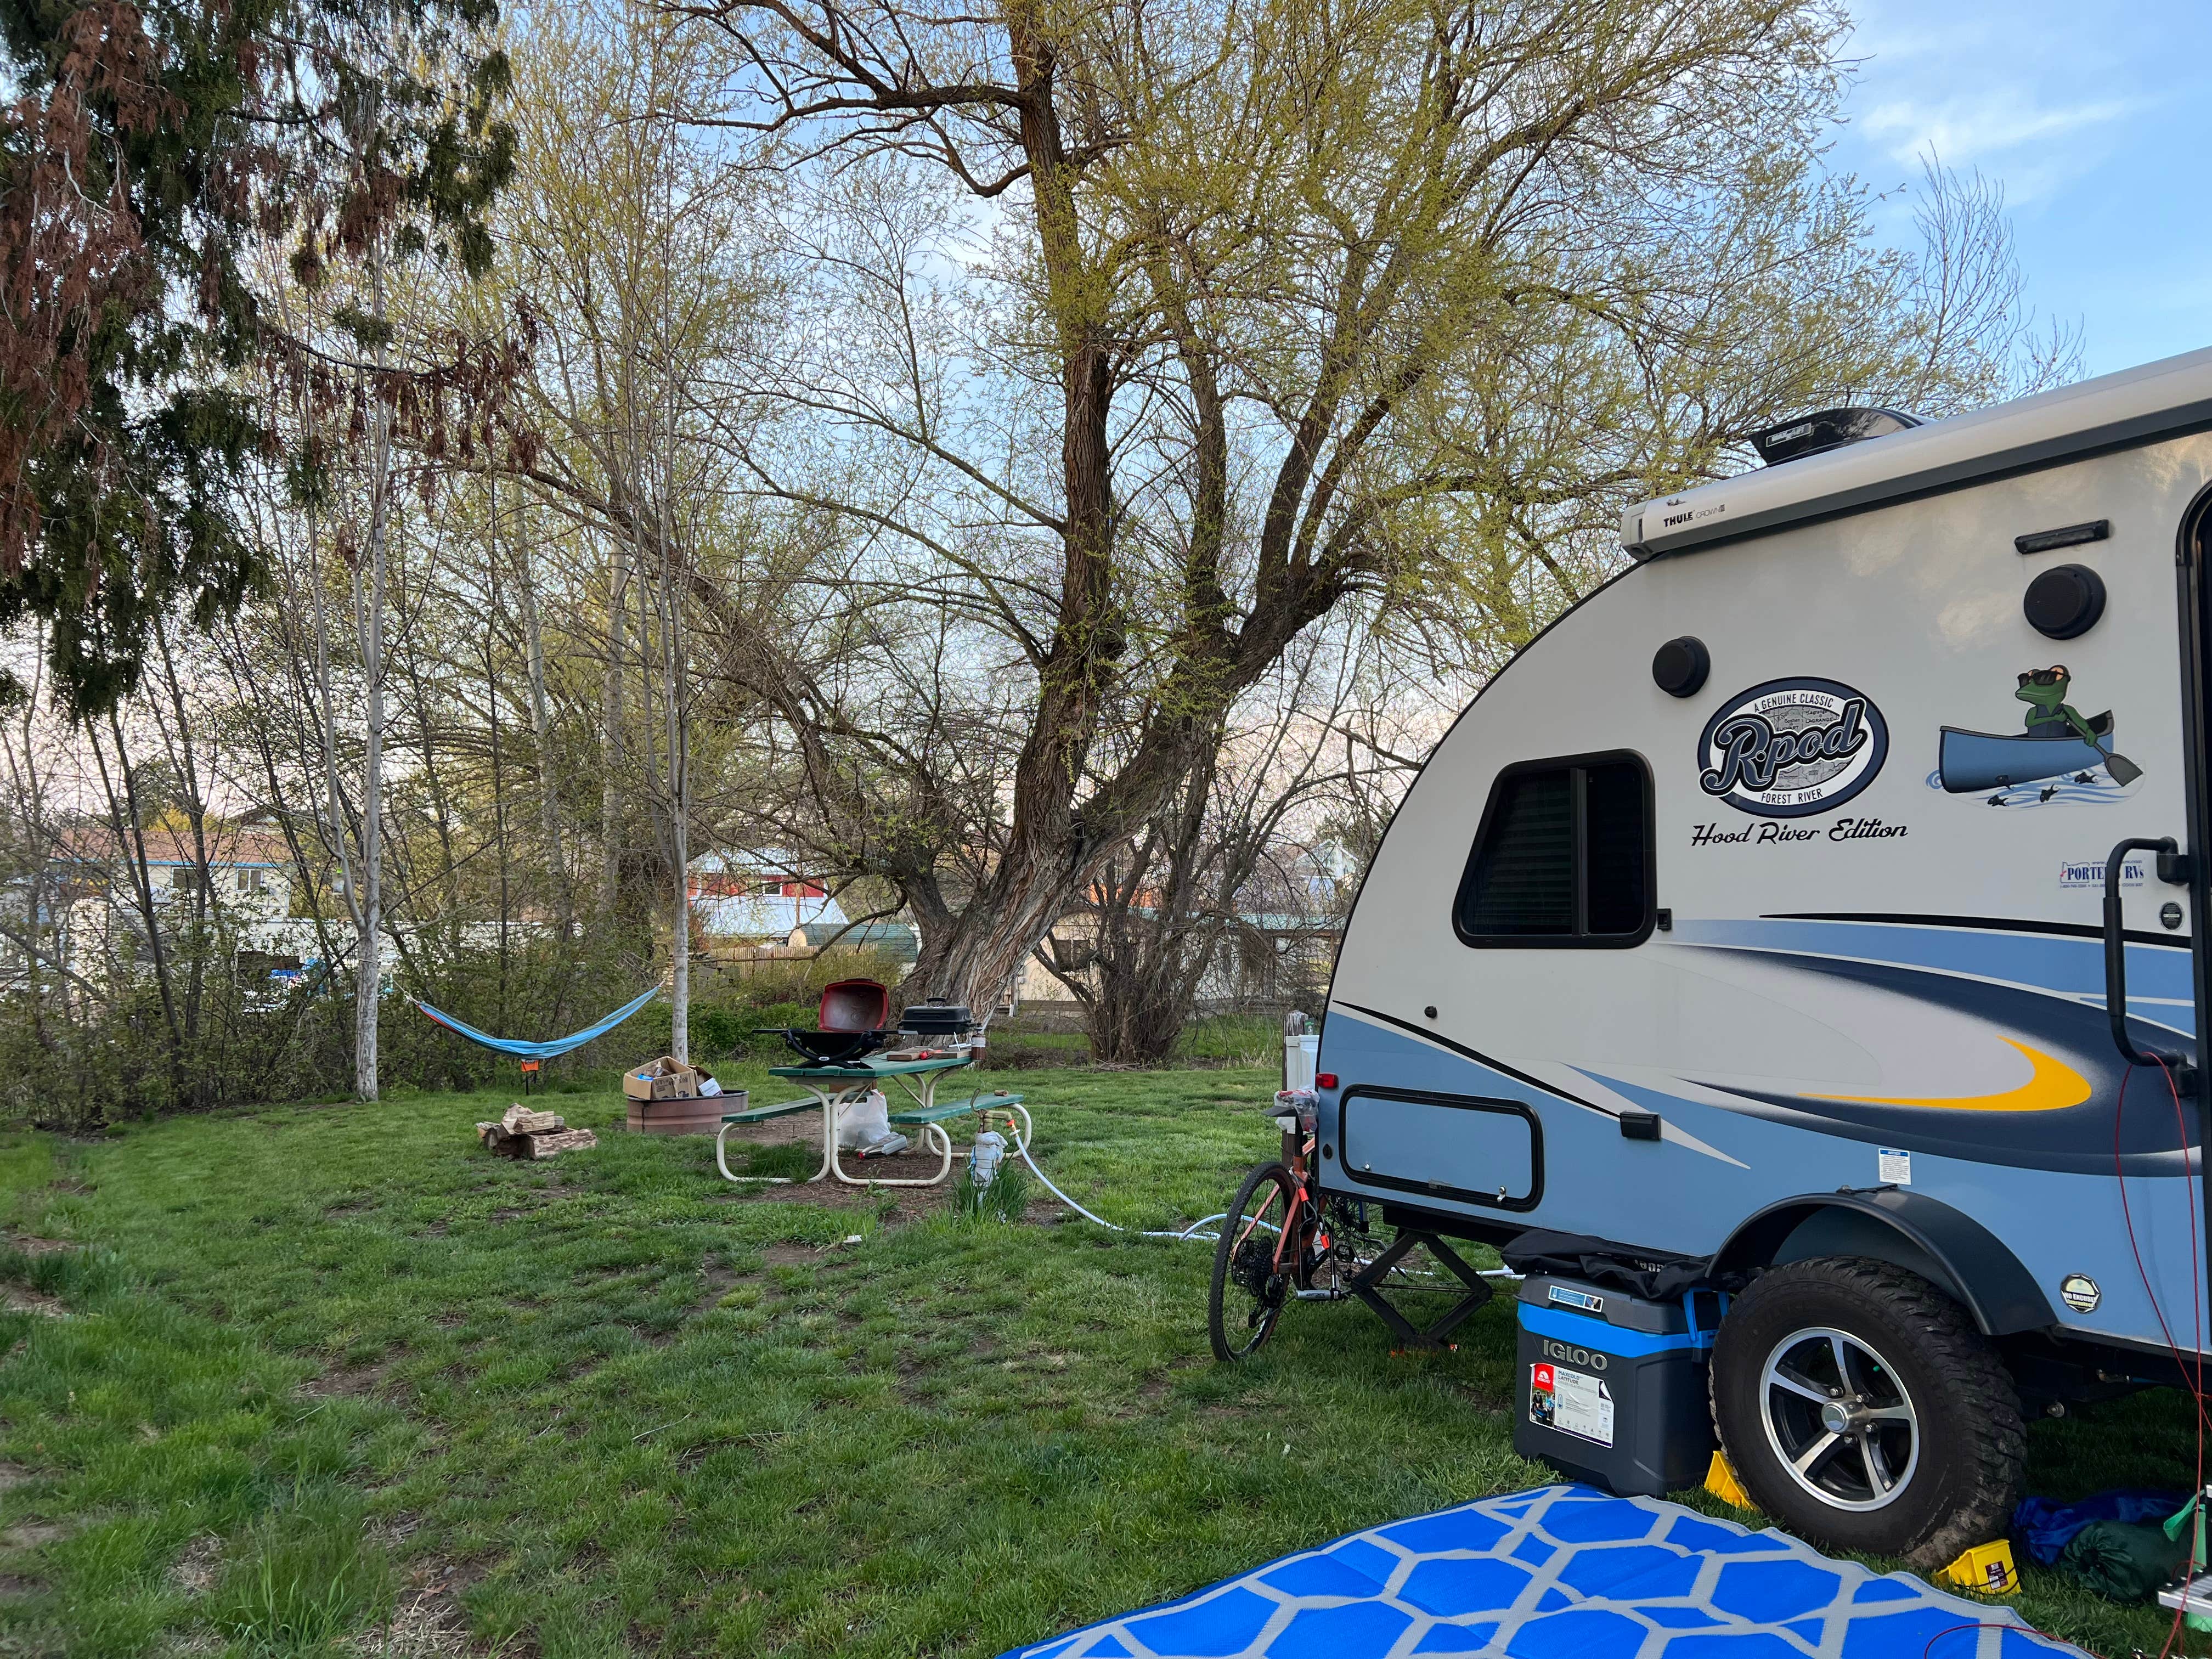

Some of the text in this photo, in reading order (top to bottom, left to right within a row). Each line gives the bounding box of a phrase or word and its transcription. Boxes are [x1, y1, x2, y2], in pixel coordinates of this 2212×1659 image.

[1663, 511, 1694, 527] THULE
[1754, 693, 1834, 713] A GENUINE CLASSIC
[1761, 788, 1824, 804] FOREST RIVER
[1691, 817, 1909, 846] Hood River Edition
[2068, 865, 2145, 881] PORTE RVs
[1543, 1339, 1608, 1371] IGLOO
[1558, 1370, 1580, 1380] MAXCOLD
[1558, 1375, 1579, 1385] LATITUDE
